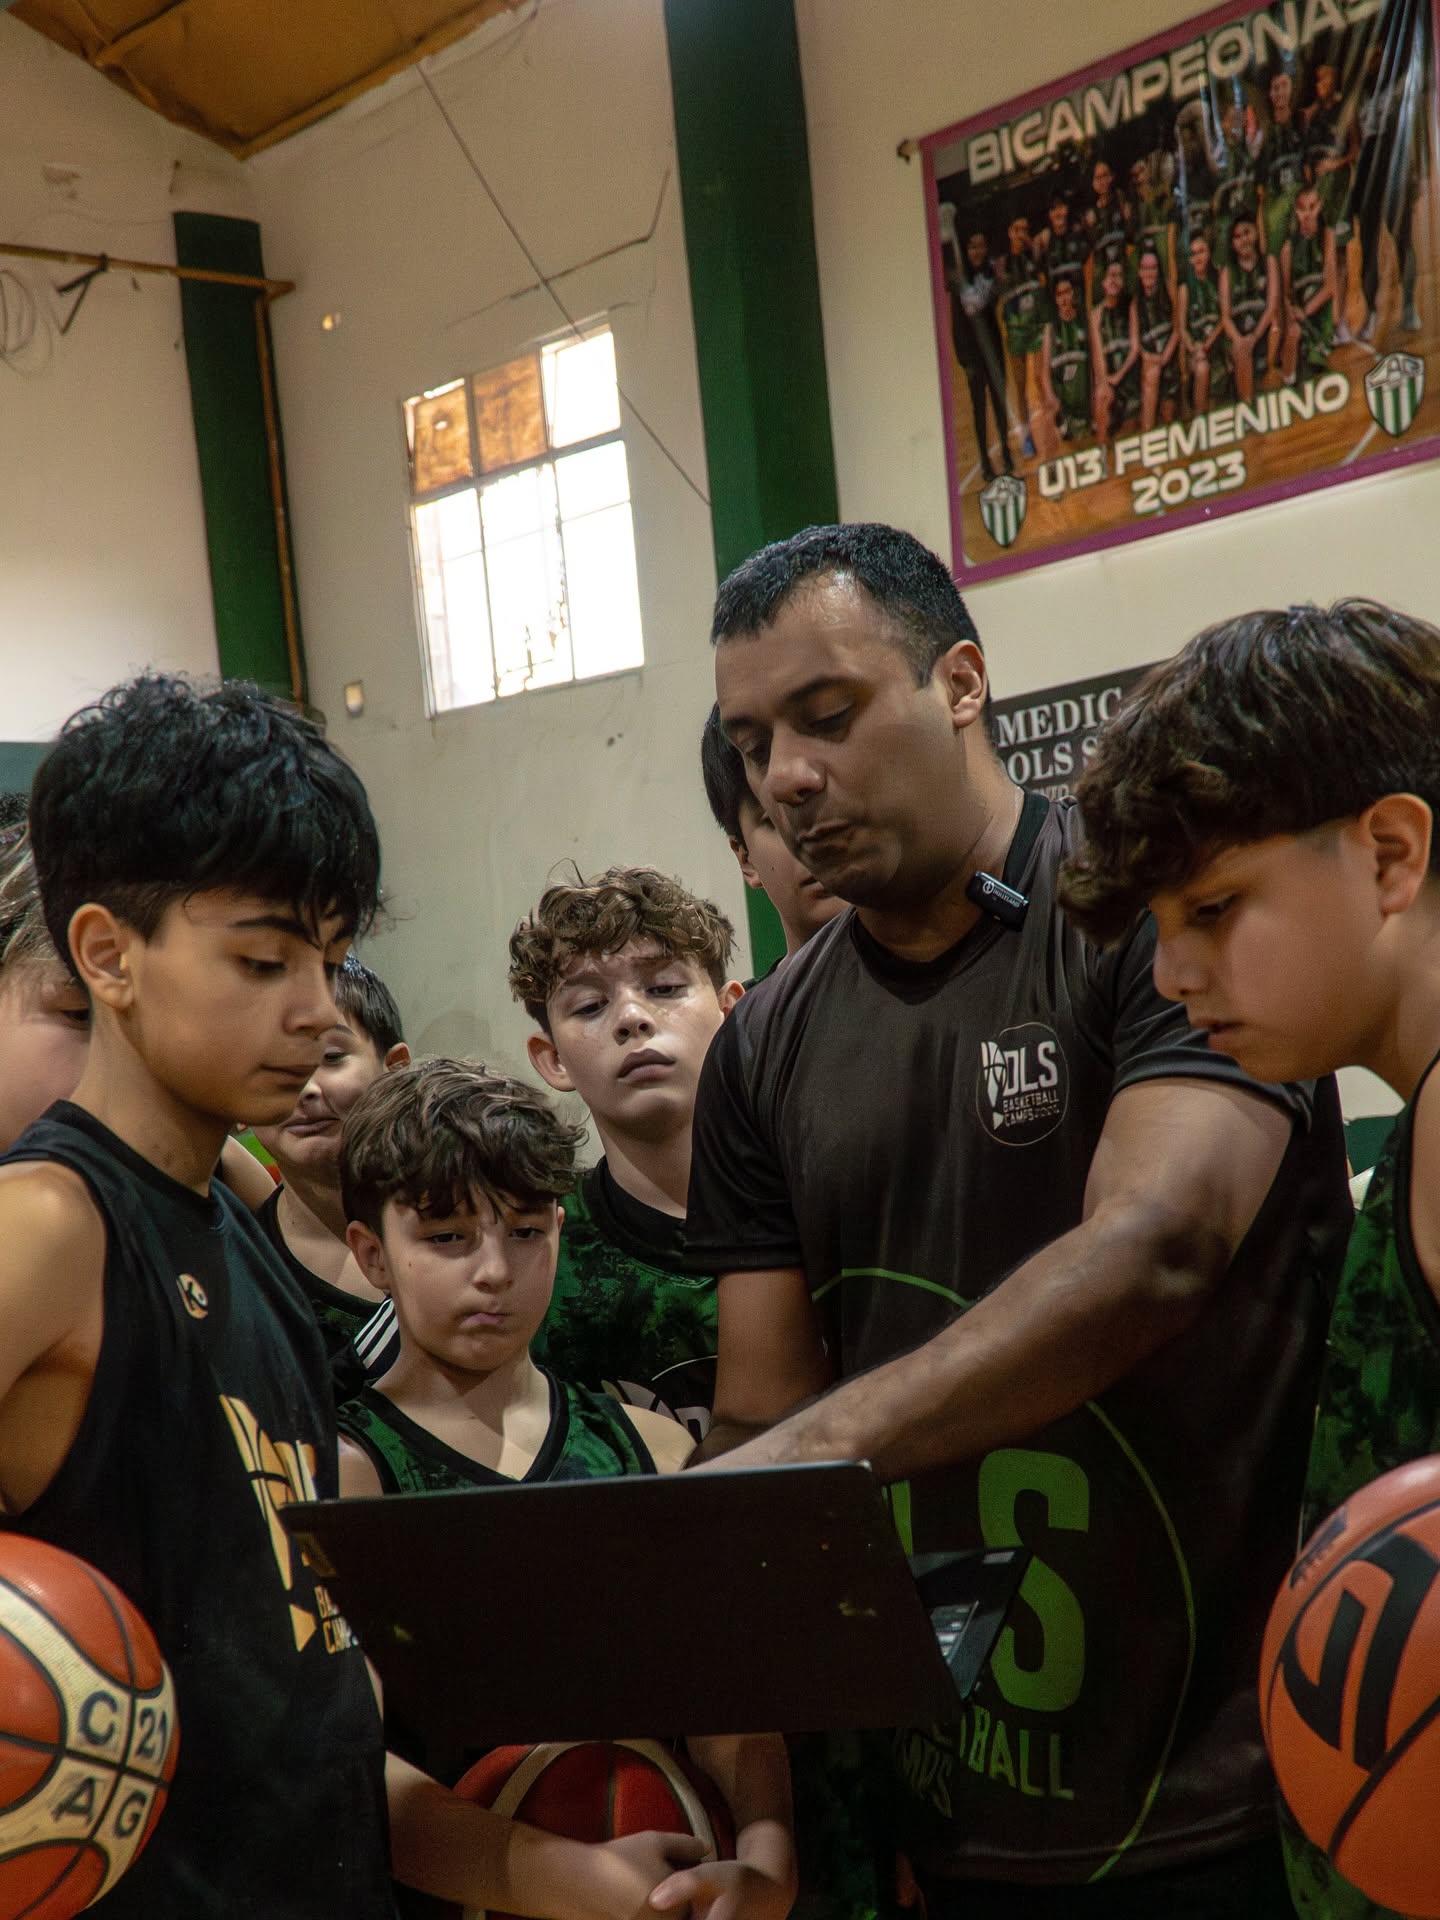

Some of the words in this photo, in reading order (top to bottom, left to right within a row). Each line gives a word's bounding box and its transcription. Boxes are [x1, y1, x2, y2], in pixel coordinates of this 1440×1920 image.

[1038, 448, 1103, 498] U13
[1114, 372, 1350, 476] FEMENINO
[1131, 450, 1247, 515] 2023
